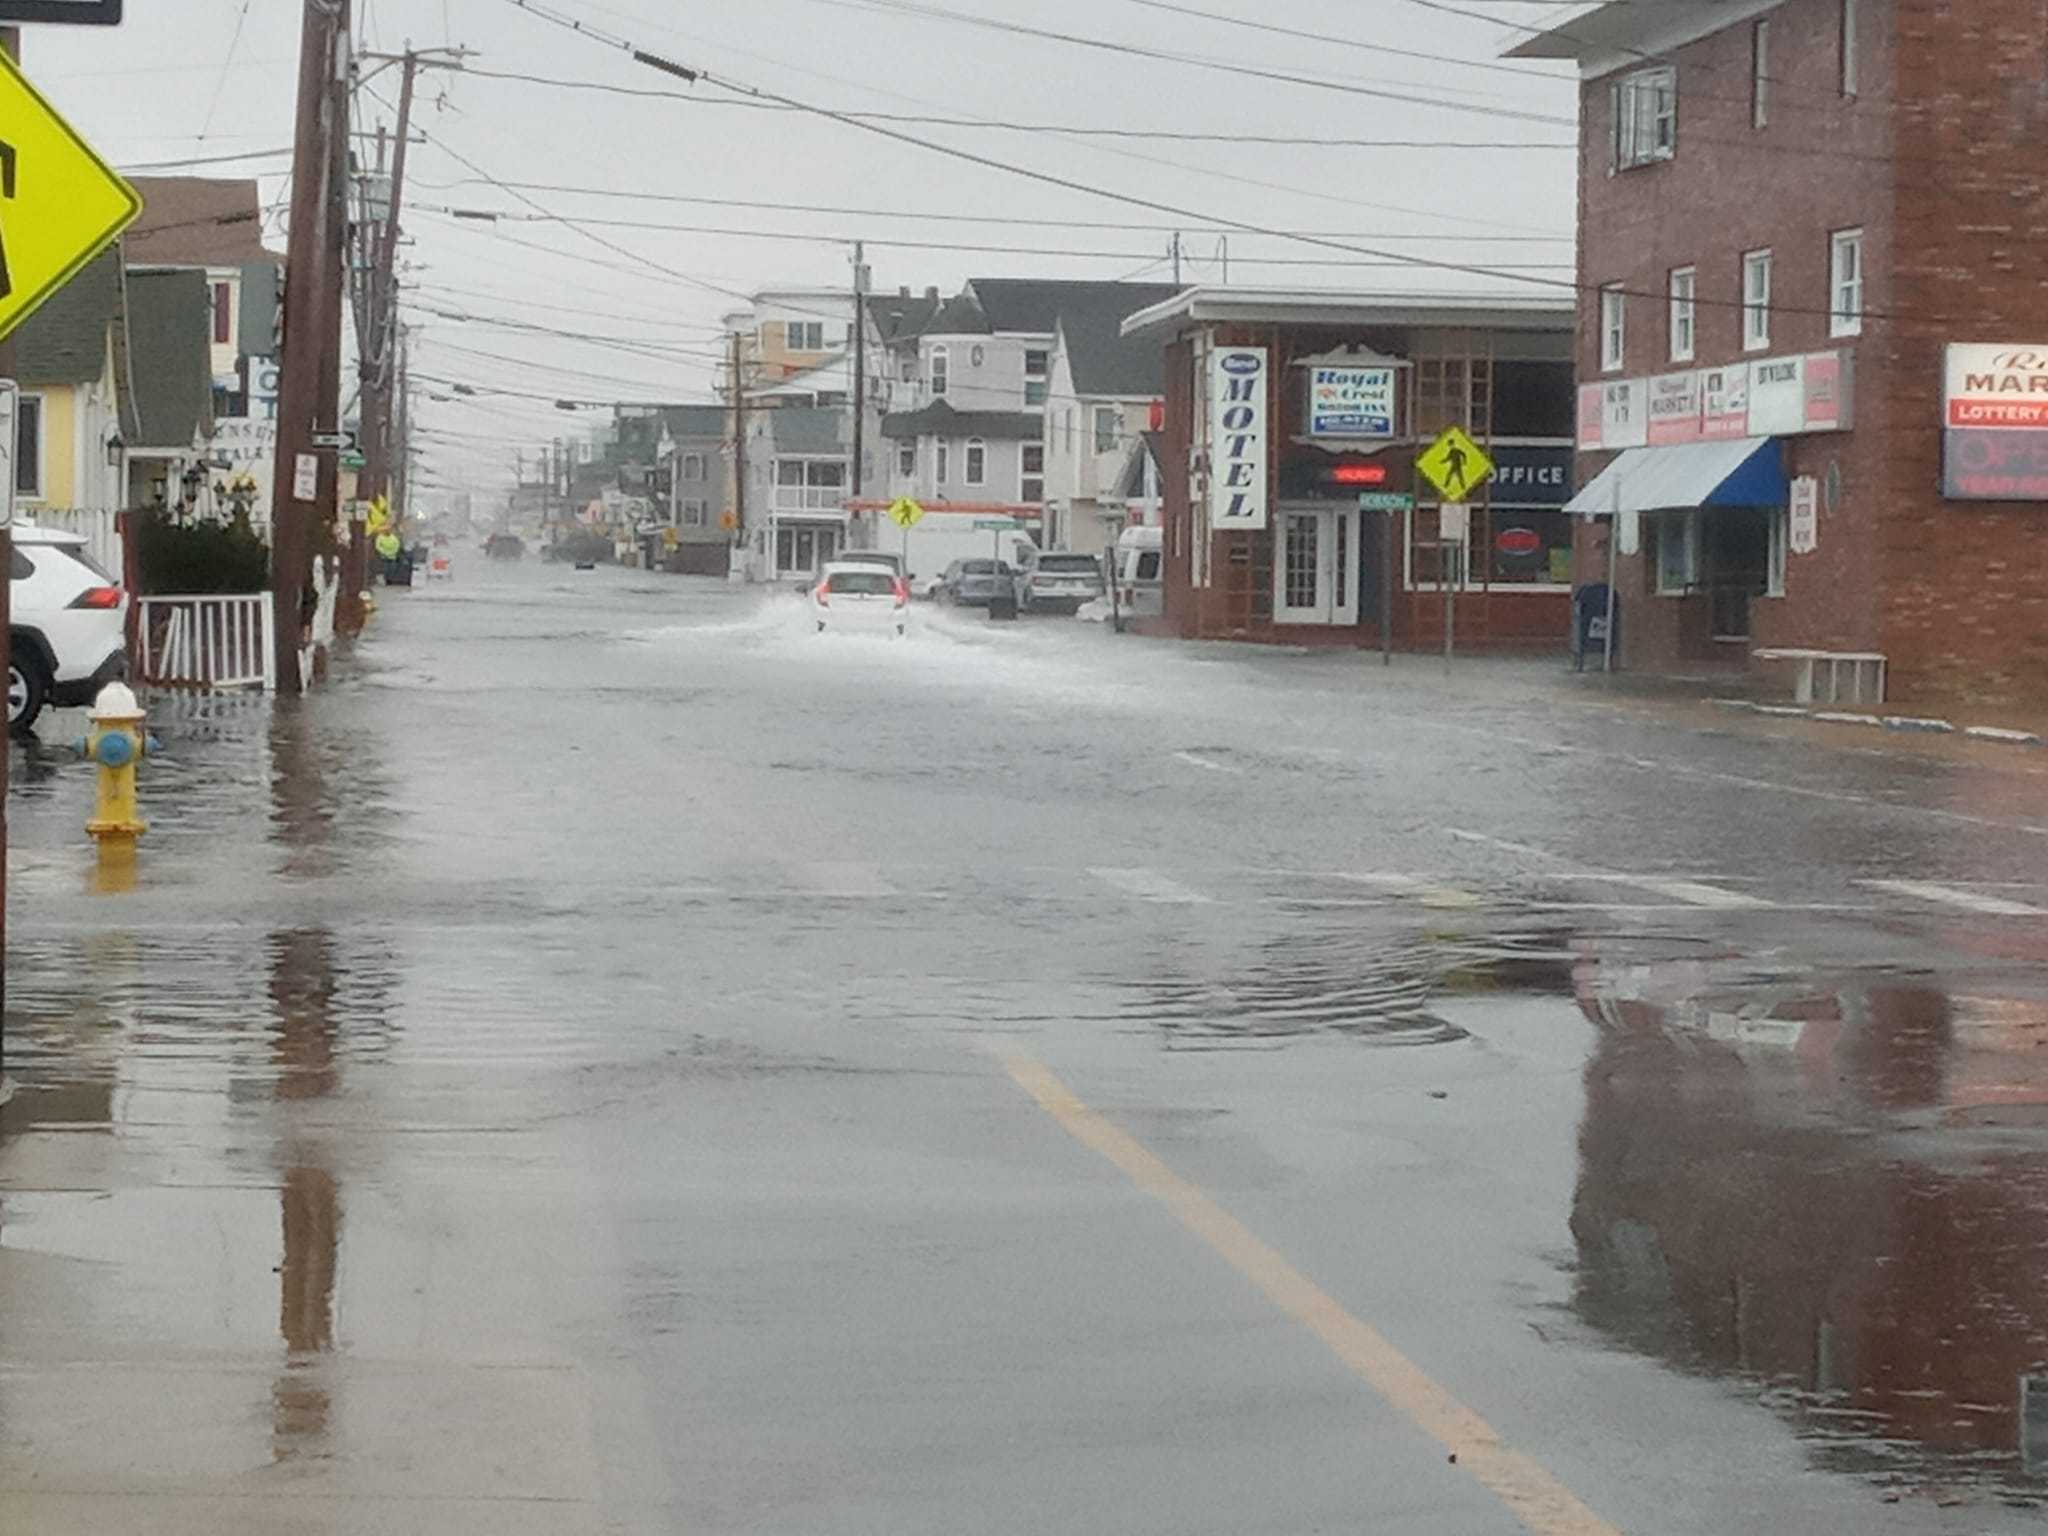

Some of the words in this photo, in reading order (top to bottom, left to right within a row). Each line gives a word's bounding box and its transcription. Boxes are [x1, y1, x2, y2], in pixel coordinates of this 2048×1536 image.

[1316, 371, 1389, 387] Royal
[1341, 388, 1386, 400] Crest
[1958, 405, 2040, 420] LOTTERY
[1222, 378, 1257, 518] MOTEL
